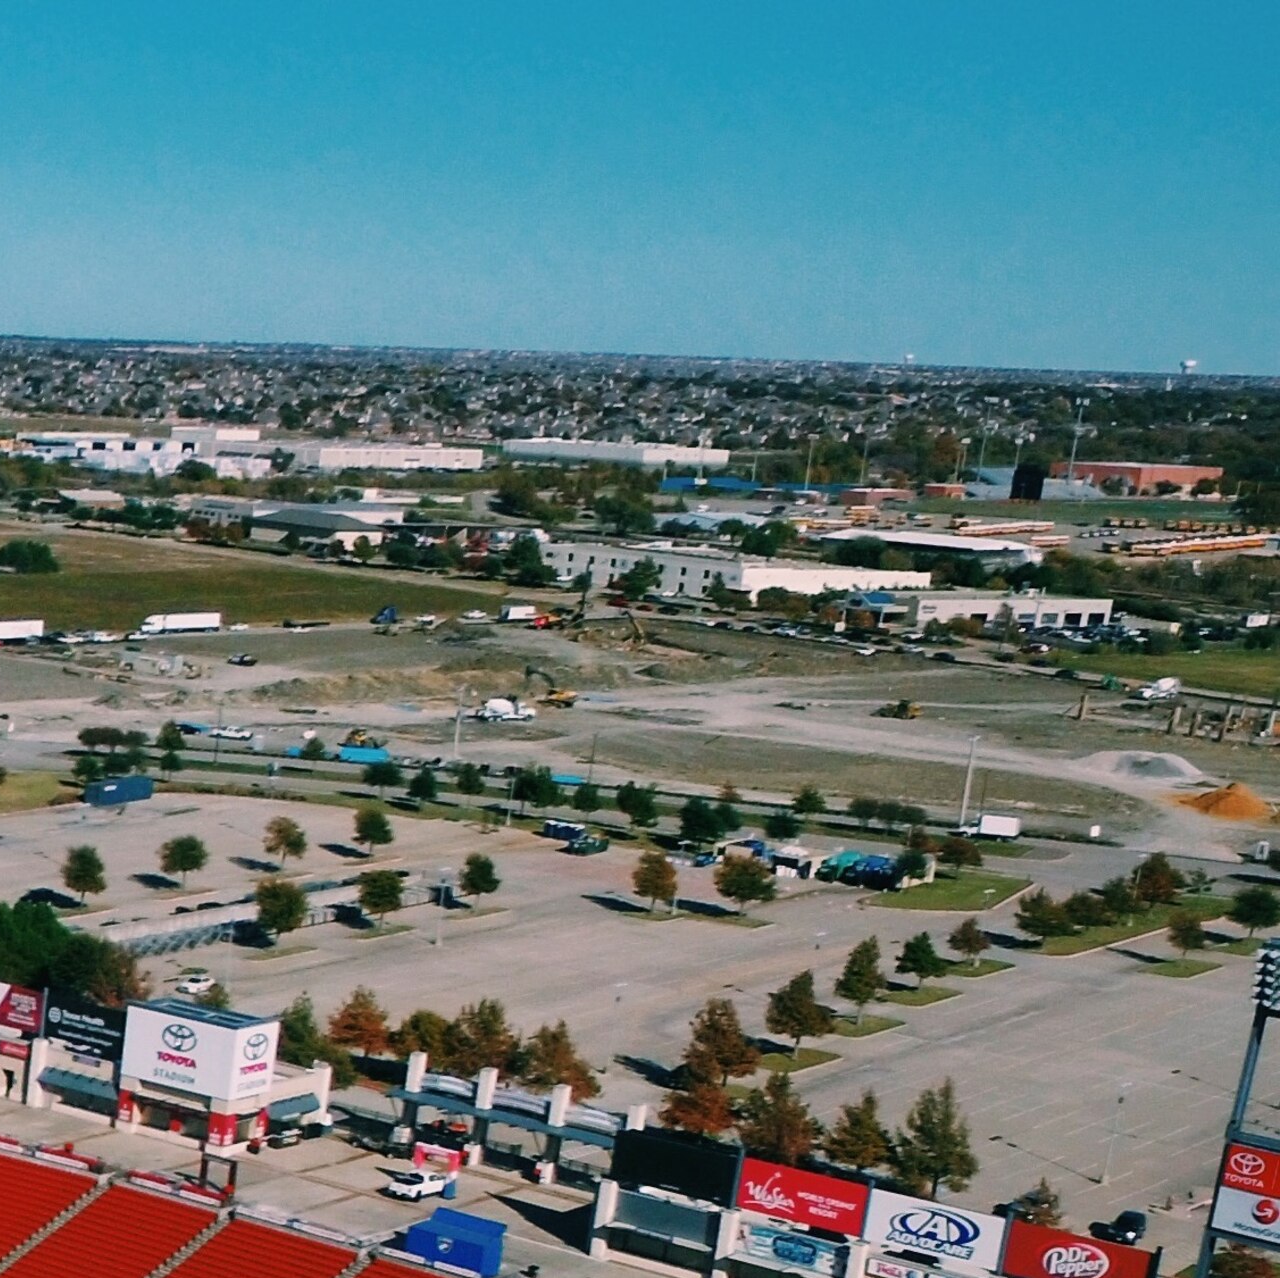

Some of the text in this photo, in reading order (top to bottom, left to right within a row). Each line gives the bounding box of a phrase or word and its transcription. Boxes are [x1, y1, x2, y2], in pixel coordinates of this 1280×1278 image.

[156, 1050, 197, 1069] TOYOTA
[239, 1061, 268, 1075] TOYOTA
[152, 1067, 196, 1086] STADIUM
[1224, 1172, 1264, 1188] TOYOTA
[886, 1230, 975, 1260] ADVOCARE
[1068, 1246, 1092, 1263] Dr
[1048, 1248, 1104, 1278] Pepper
